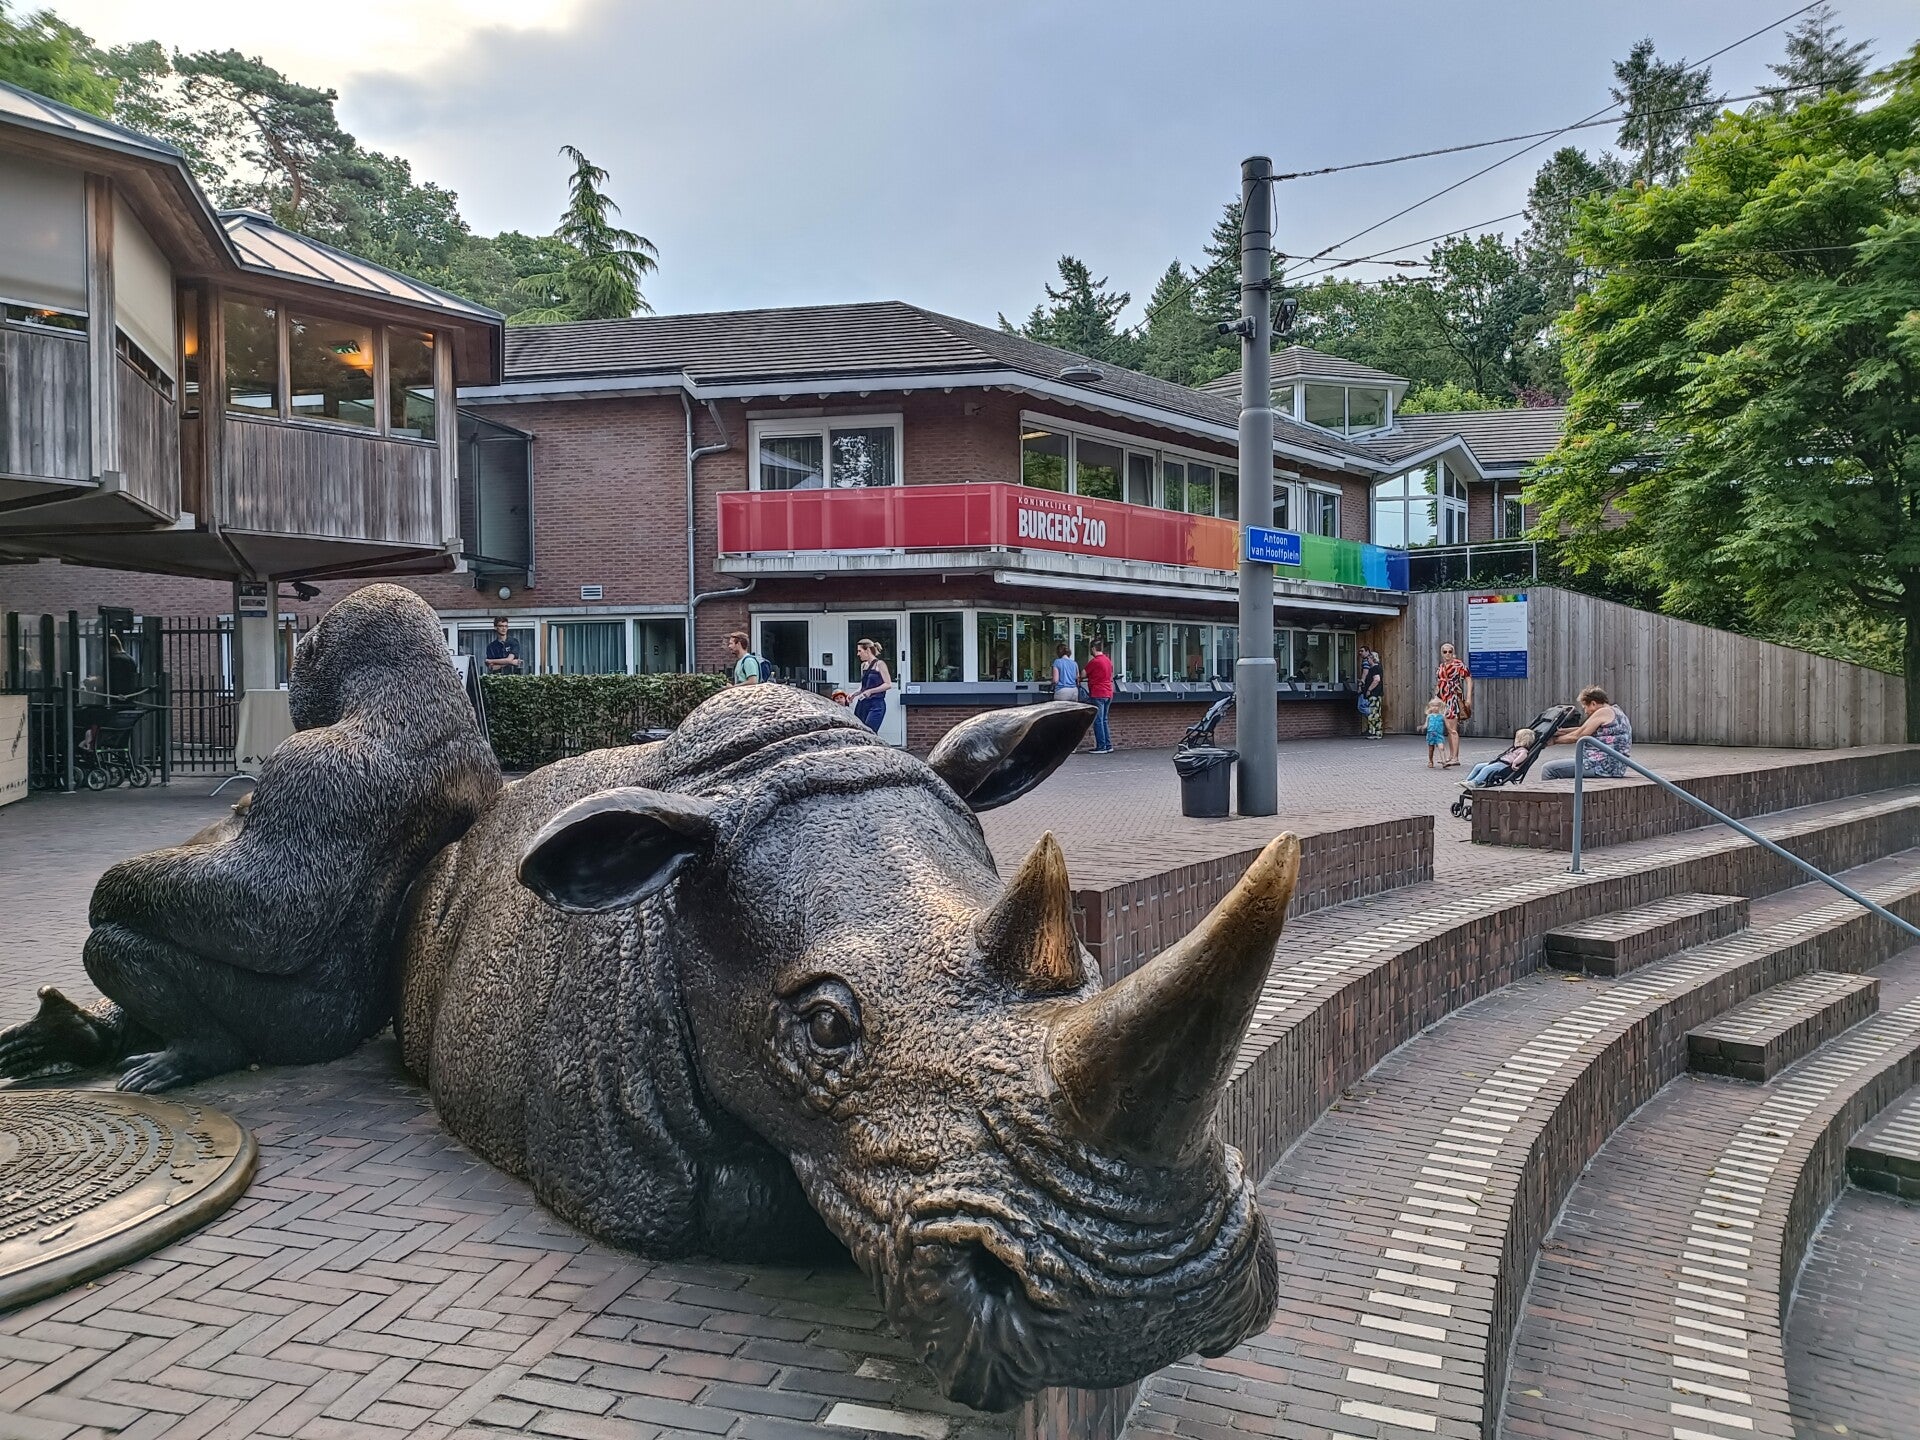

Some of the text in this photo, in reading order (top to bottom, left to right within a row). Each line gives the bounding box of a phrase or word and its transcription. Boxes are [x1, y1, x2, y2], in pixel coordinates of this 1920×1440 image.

[1018, 496, 1071, 511] KONINKLIJKE
[1263, 532, 1288, 546] Antoon
[1251, 546, 1299, 560] van Hooffplein
[1041, 620, 1046, 631] 1
[1095, 623, 1101, 633] 2
[1136, 624, 1141, 634] 3
[1184, 627, 1189, 637] 4
[0, 1209, 38, 1229] ente
[38, 1184, 100, 1213] Arnhem
